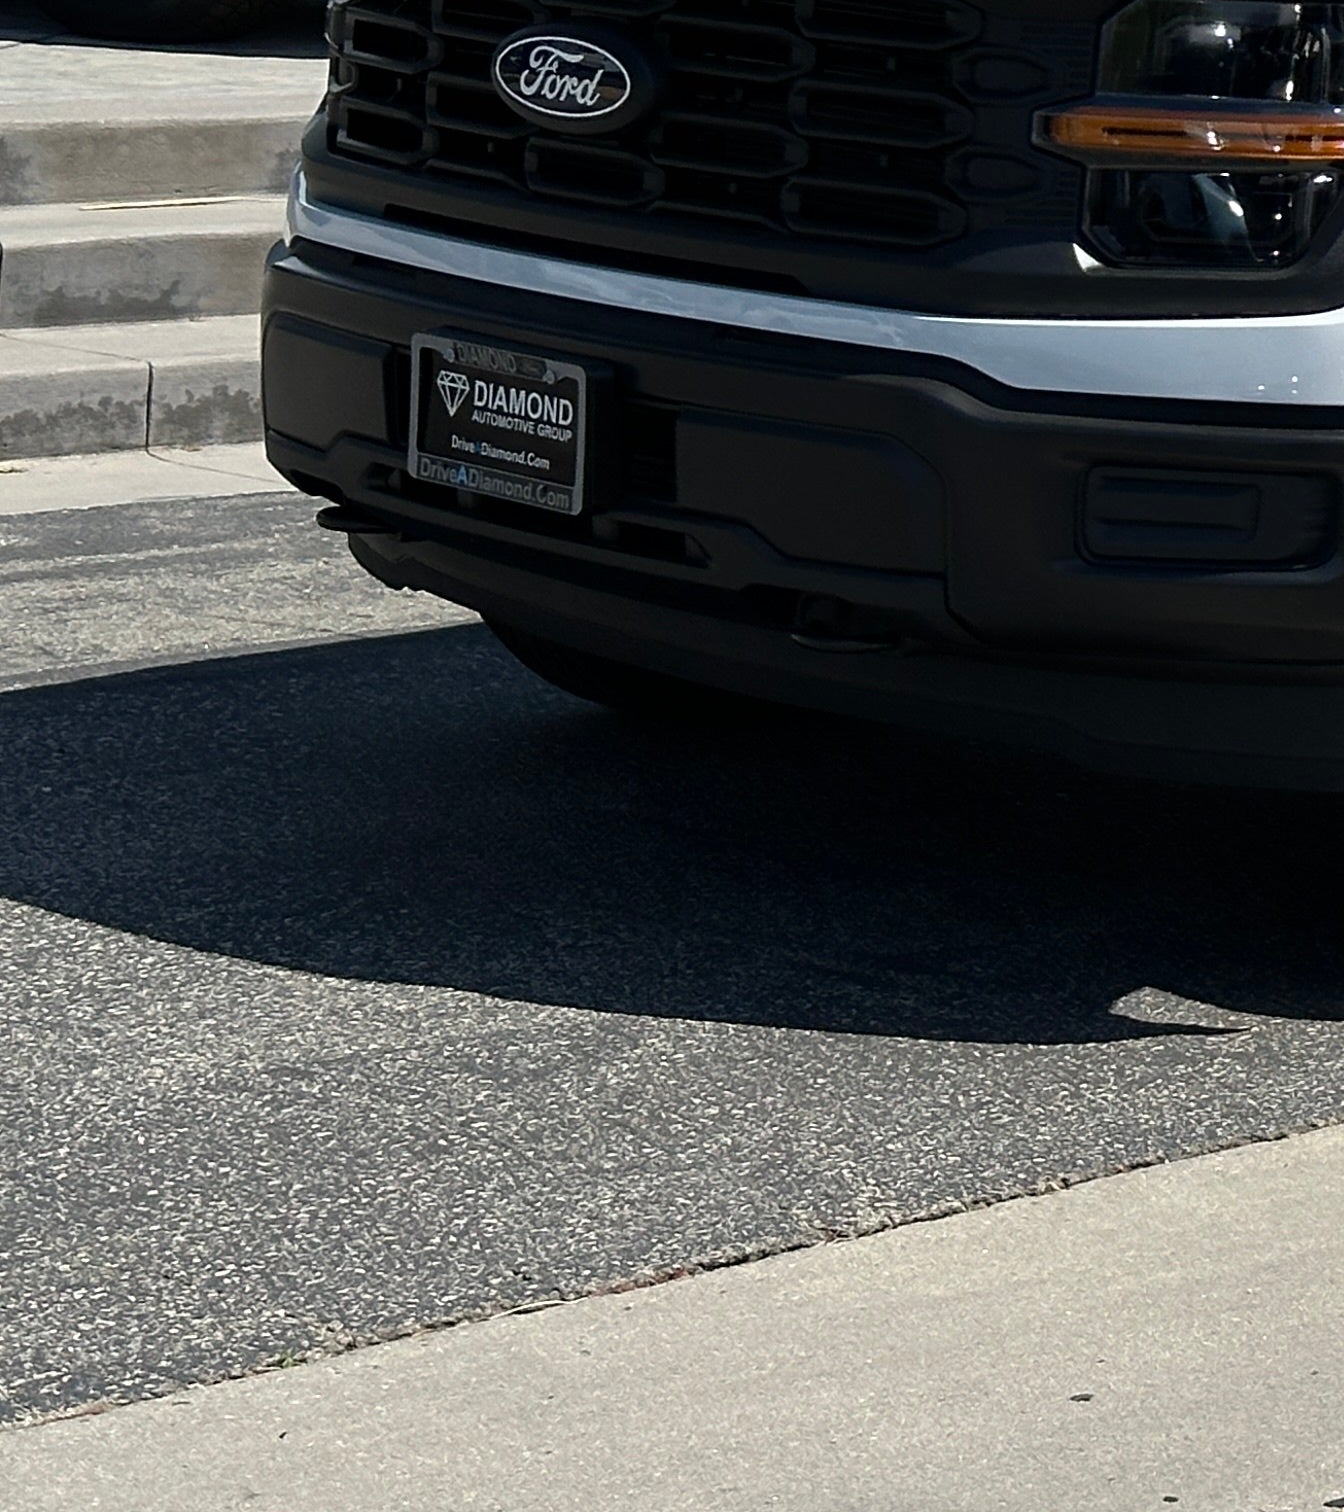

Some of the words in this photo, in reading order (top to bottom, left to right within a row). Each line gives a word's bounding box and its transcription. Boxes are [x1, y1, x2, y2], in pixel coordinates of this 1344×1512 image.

[520, 45, 604, 106] Ford
[471, 408, 535, 436] AUTOMOTIVE
[537, 422, 573, 444] GROUP
[473, 379, 574, 427] DIAMOND
[420, 457, 570, 509] DriveADiamond.Com
